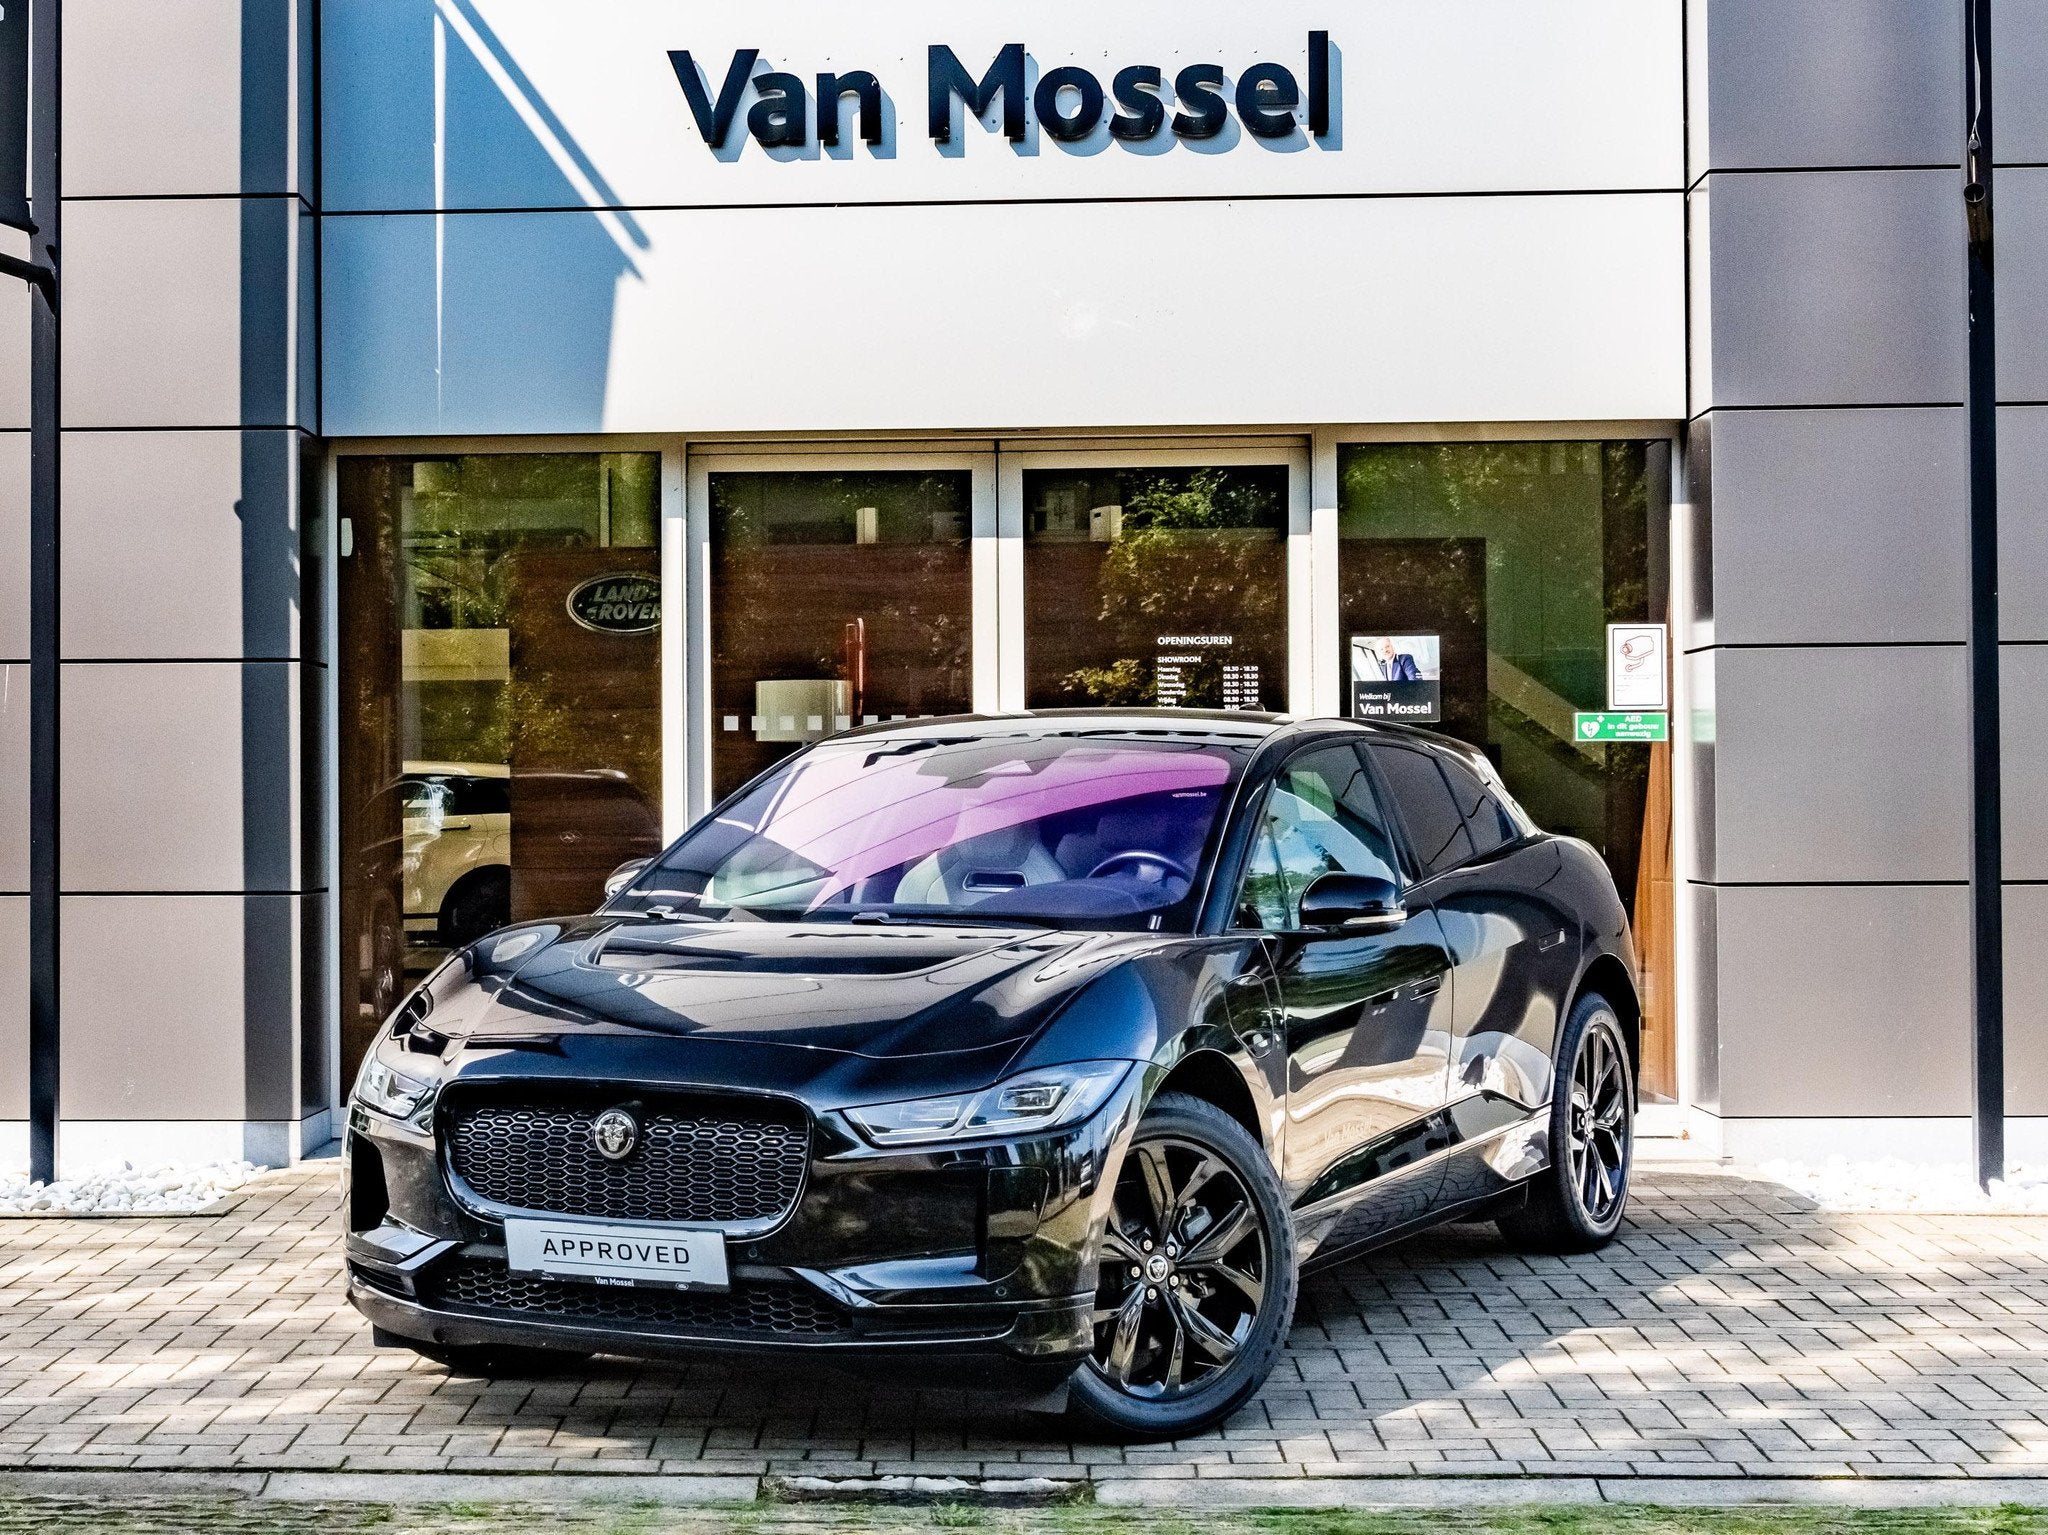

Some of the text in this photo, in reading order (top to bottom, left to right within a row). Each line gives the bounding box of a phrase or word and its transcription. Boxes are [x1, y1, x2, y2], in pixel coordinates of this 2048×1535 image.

[667, 30, 1329, 146] Van Mossel
[593, 585, 649, 602] LAND
[1157, 636, 1233, 645] OPENINGSUREN
[1383, 693, 1391, 701] bij
[1359, 702, 1431, 714] Van Mossel
[543, 1238, 690, 1264] APPROVED
[595, 1277, 635, 1287] Van Mossel
